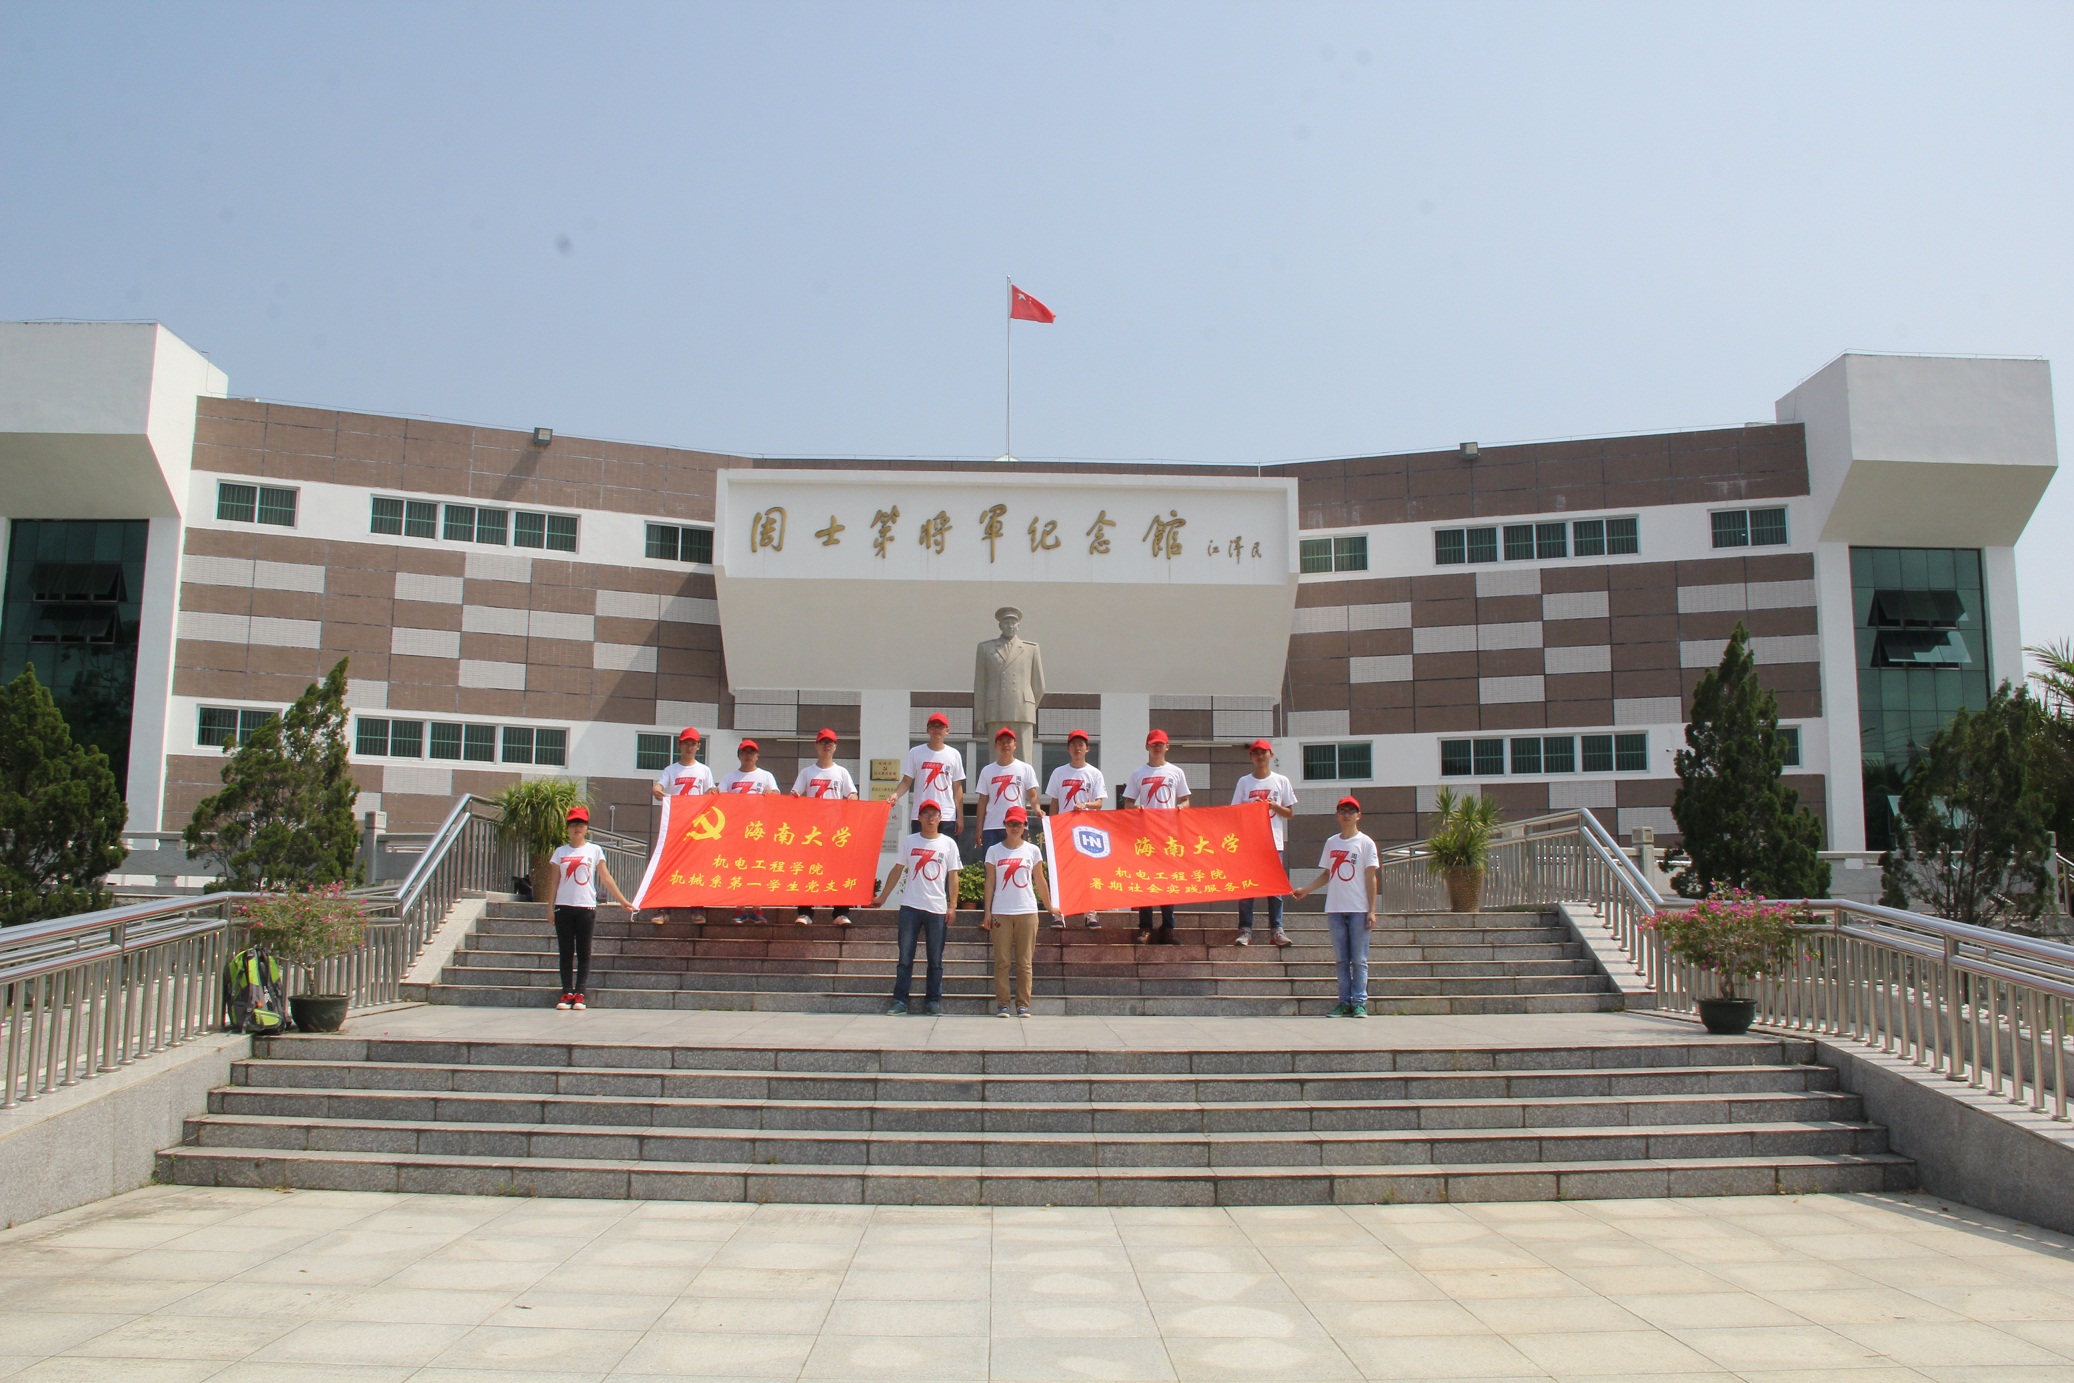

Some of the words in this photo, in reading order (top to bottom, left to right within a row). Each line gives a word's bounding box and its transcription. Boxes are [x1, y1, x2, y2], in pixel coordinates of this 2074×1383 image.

[991, 774, 1020, 805] 70
[1141, 776, 1171, 806] 70
[744, 821, 852, 848] 海南大学
[1081, 834, 1103, 849] HN
[1133, 832, 1240, 858] 海南大学
[712, 854, 824, 876] 机电工程学院
[910, 848, 941, 881] 70
[997, 858, 1029, 891] 70
[1115, 867, 1227, 882] 机电工程学院
[1329, 850, 1356, 882] 70
[669, 869, 858, 893] 机械系第一学生党支部
[1089, 878, 1259, 894] 暑期社会实践服务队
